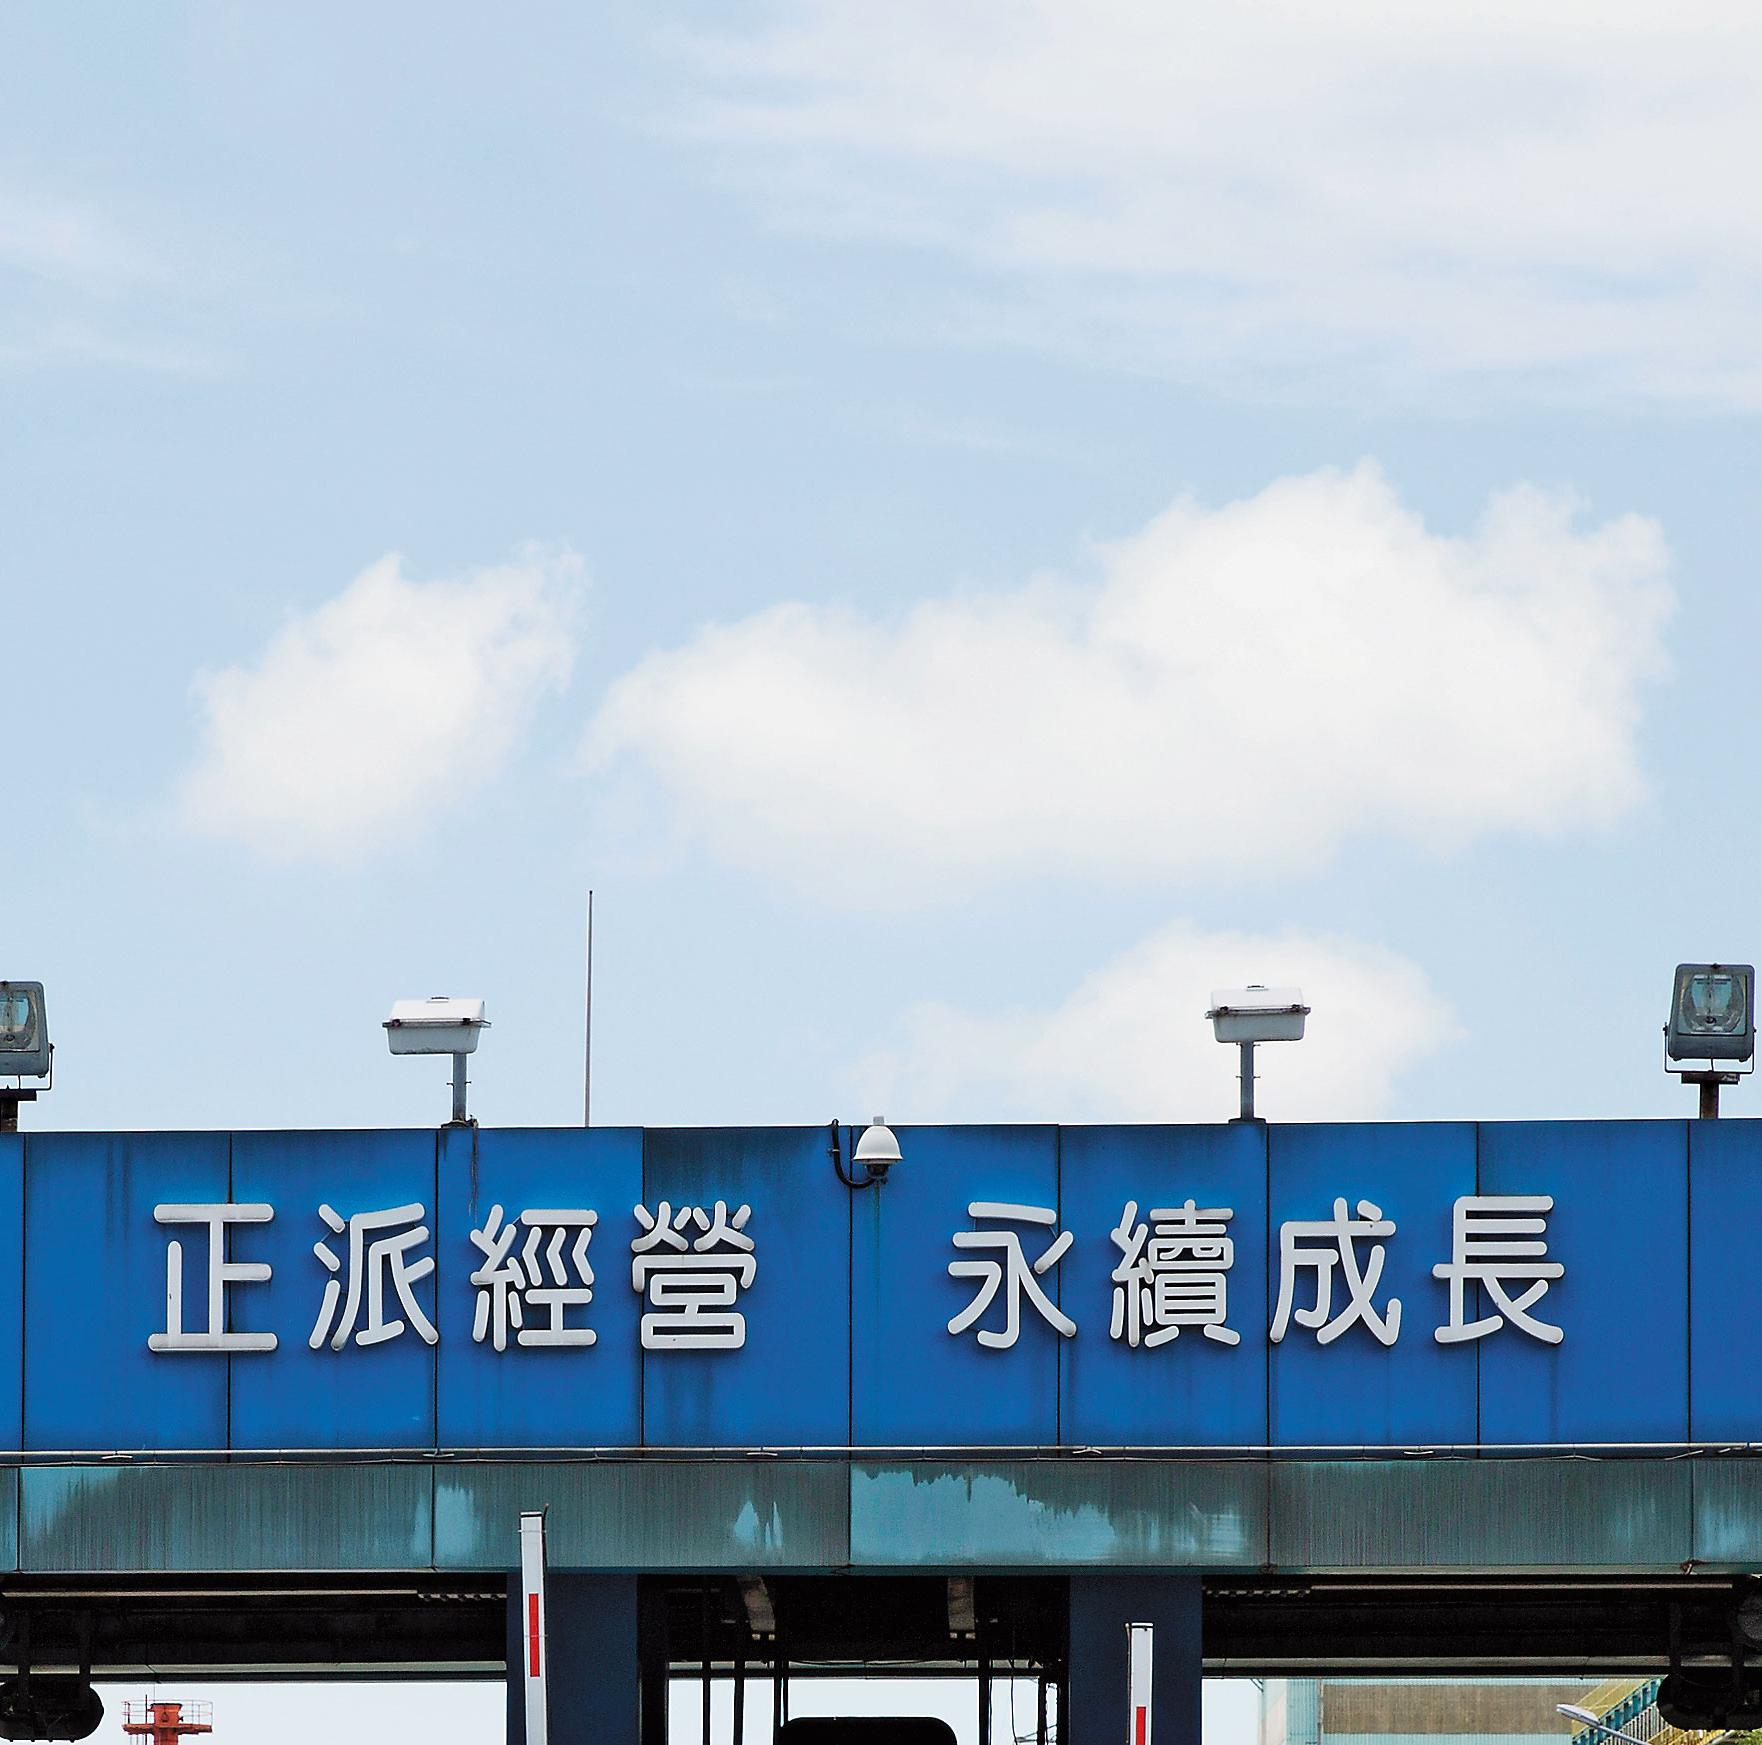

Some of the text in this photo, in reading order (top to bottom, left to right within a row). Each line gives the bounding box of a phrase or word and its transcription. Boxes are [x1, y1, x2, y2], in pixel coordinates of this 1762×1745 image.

[147, 1195, 1566, 1354] 正派經營 永續成長
